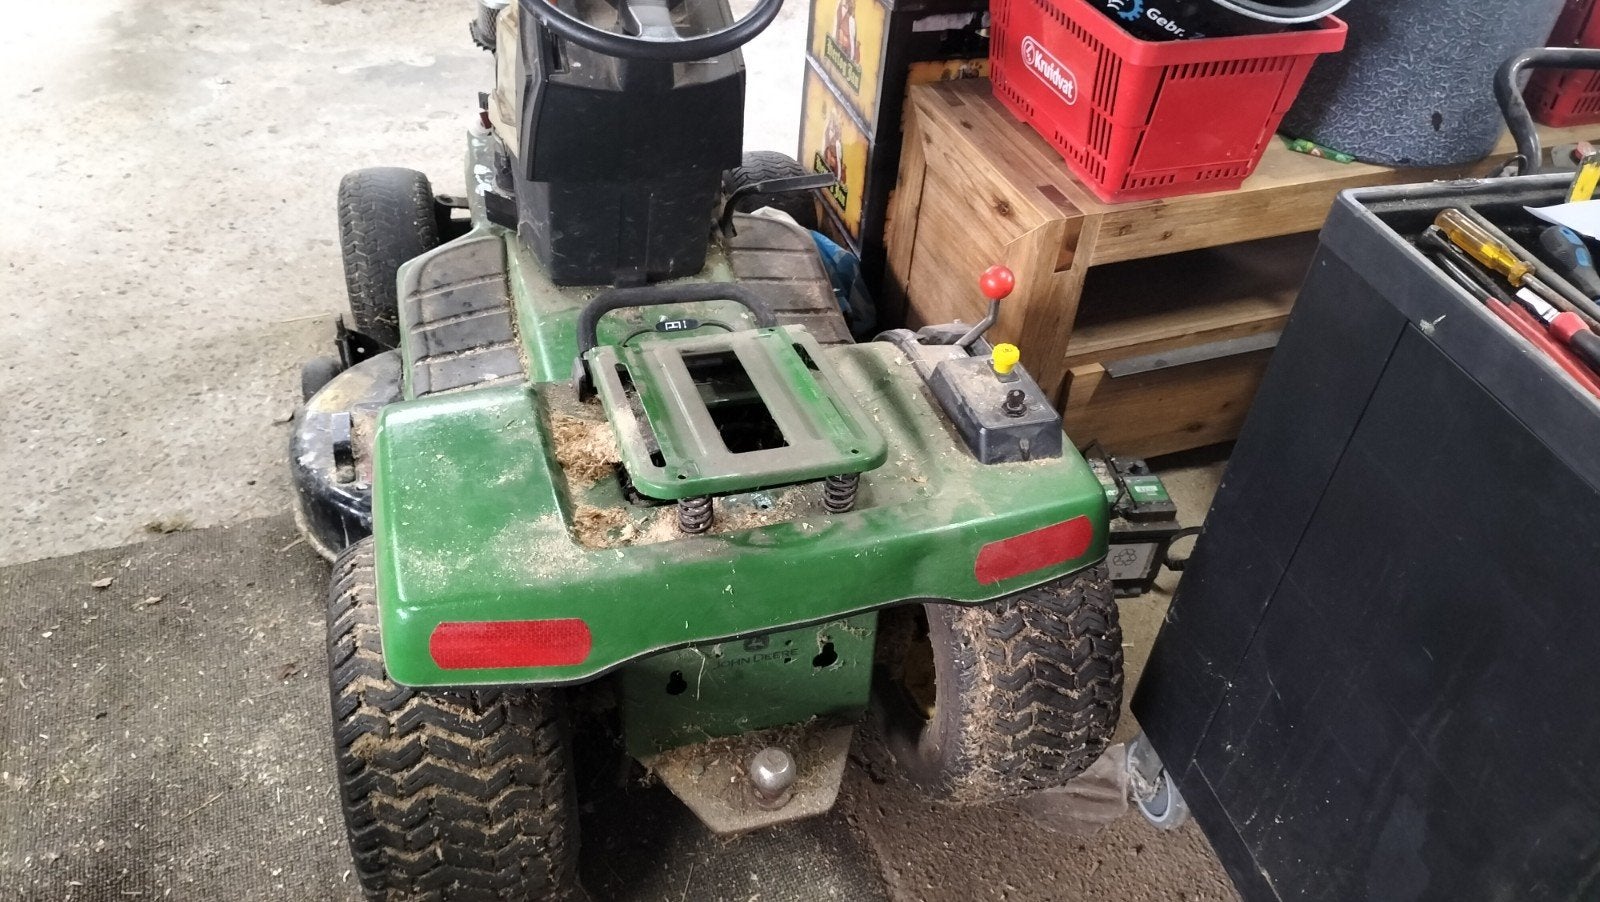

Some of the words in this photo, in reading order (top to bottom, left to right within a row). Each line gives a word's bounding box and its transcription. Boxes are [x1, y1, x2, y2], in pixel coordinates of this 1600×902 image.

[1146, 8, 1186, 37] Gebr.
[1034, 50, 1073, 98] Kruidvat
[713, 656, 751, 669] JOHN
[753, 648, 799, 663] DEERE
